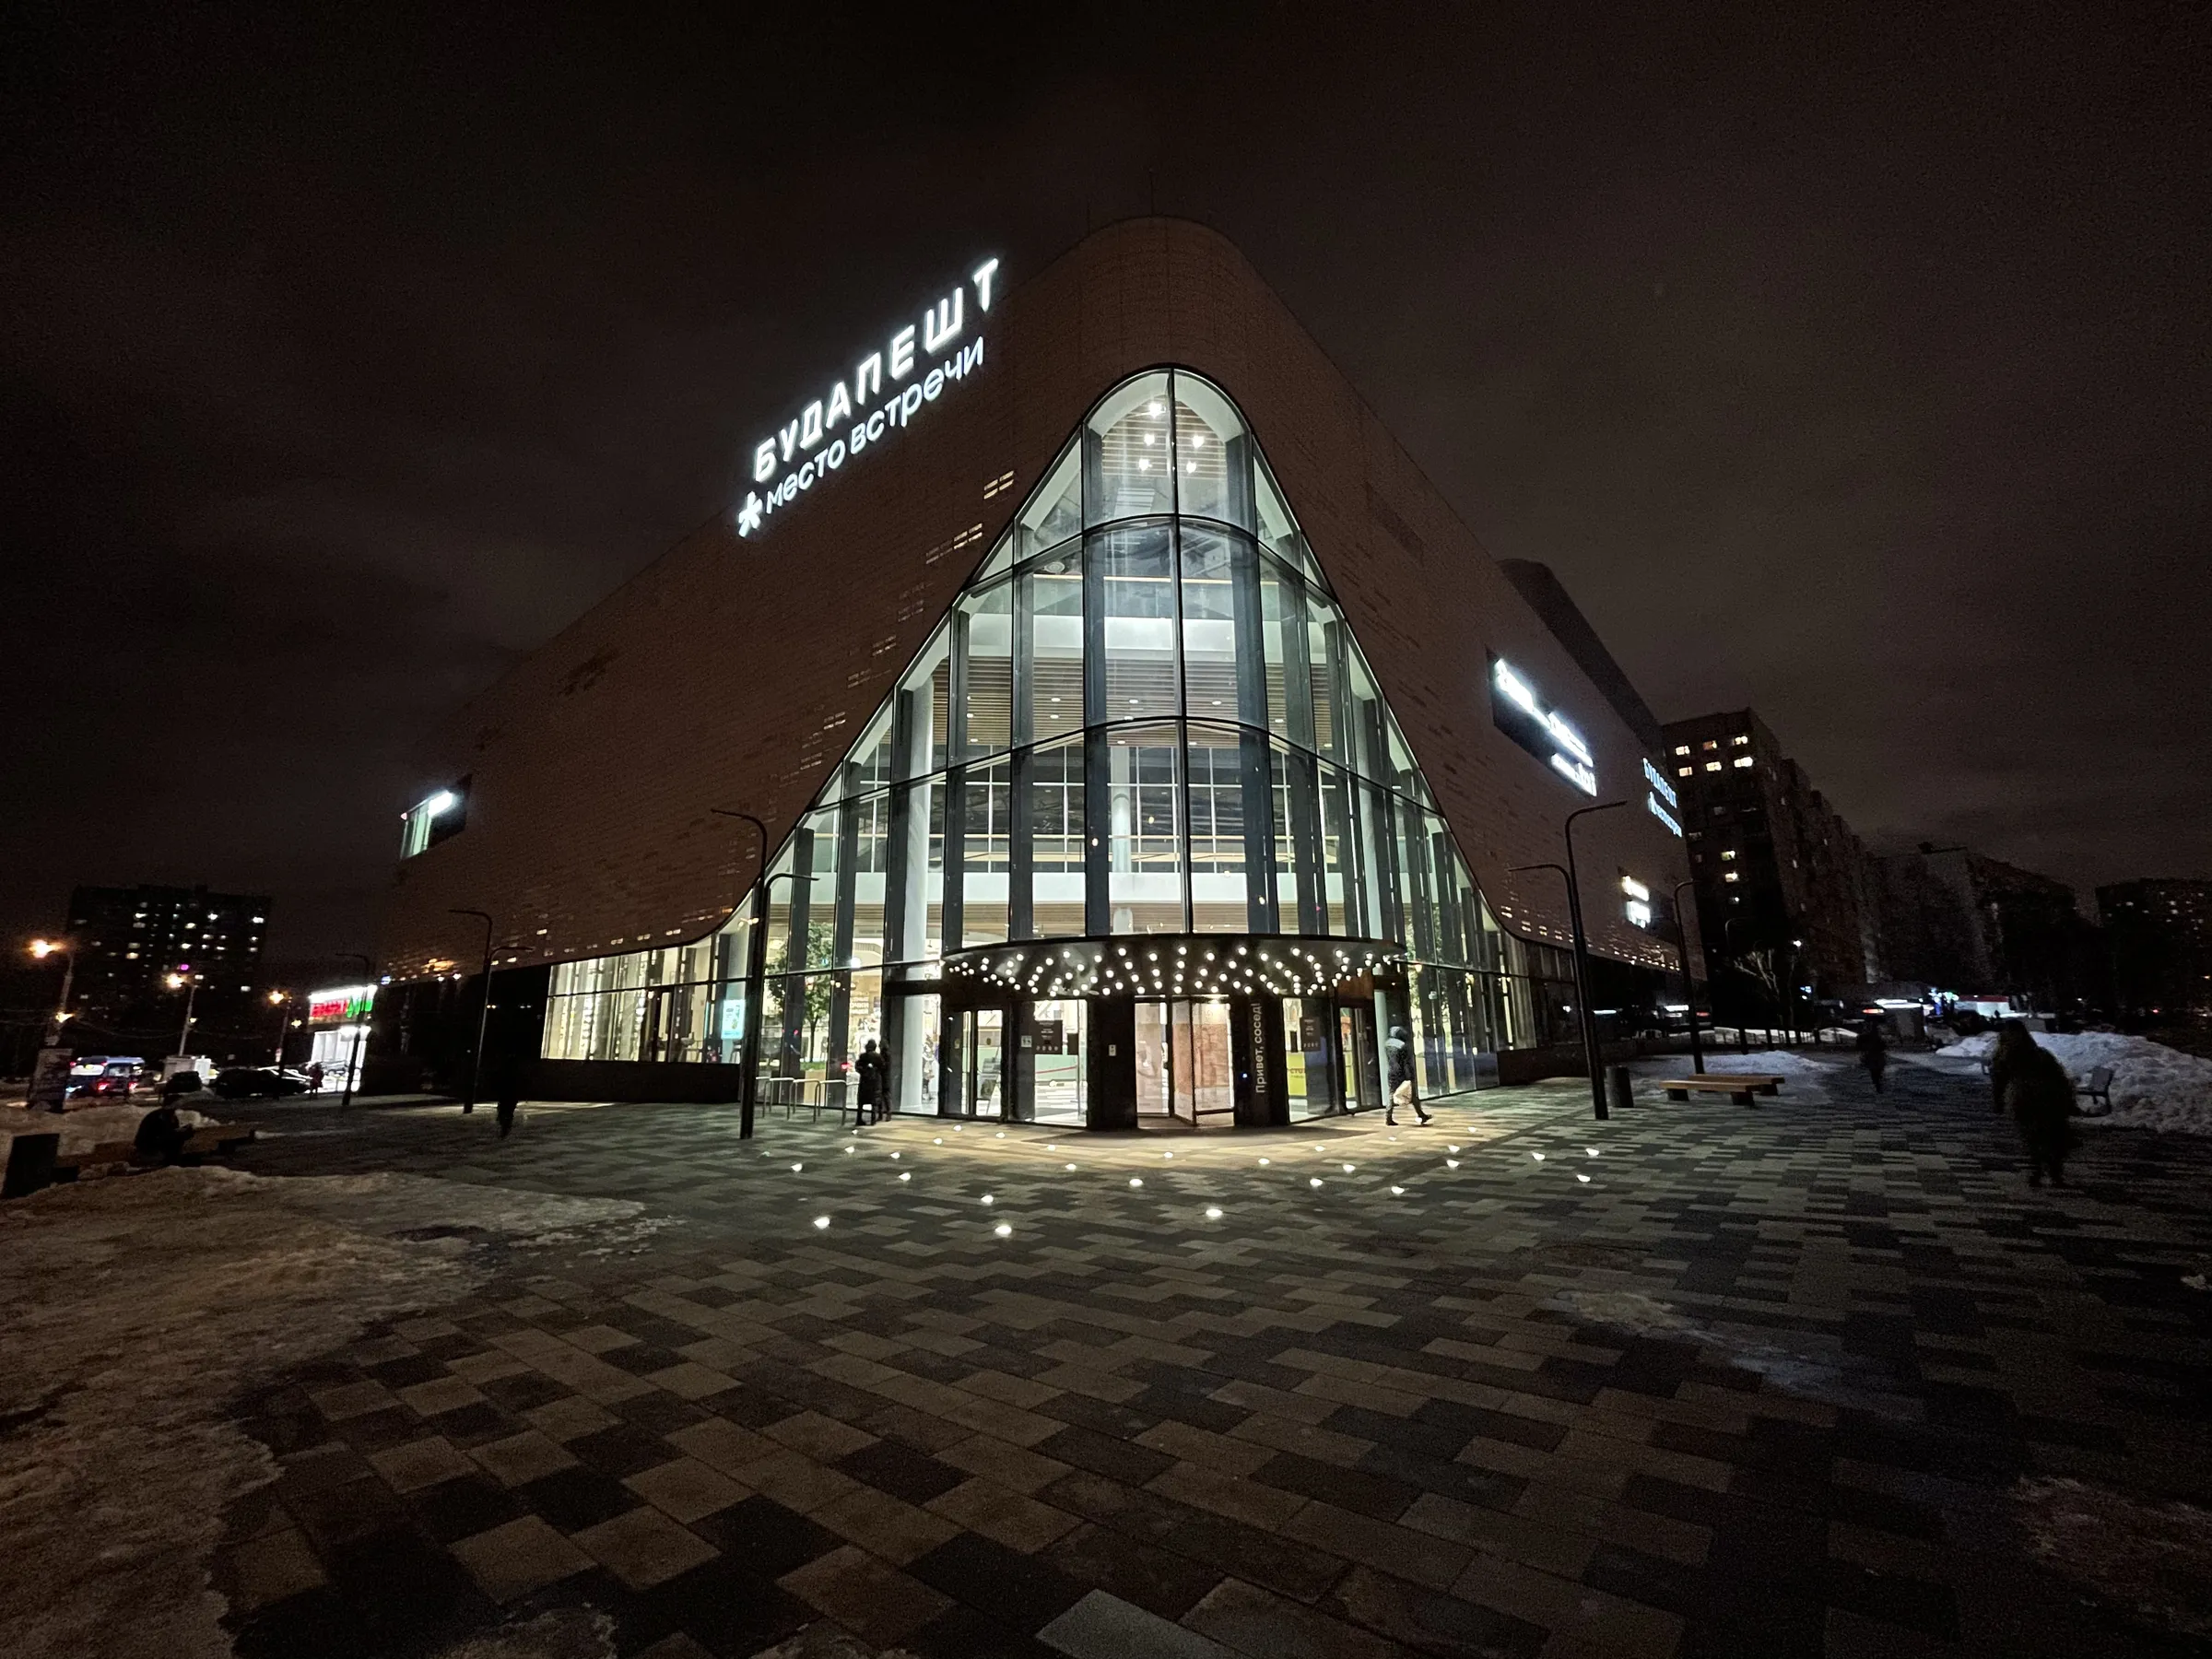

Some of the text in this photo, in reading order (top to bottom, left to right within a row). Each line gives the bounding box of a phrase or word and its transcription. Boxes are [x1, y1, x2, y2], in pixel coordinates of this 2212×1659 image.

[753, 257, 999, 483] БУДАПЕШТ
[765, 335, 985, 514] место встречи
[1251, 1003, 1267, 1094] Привет, сосед!
